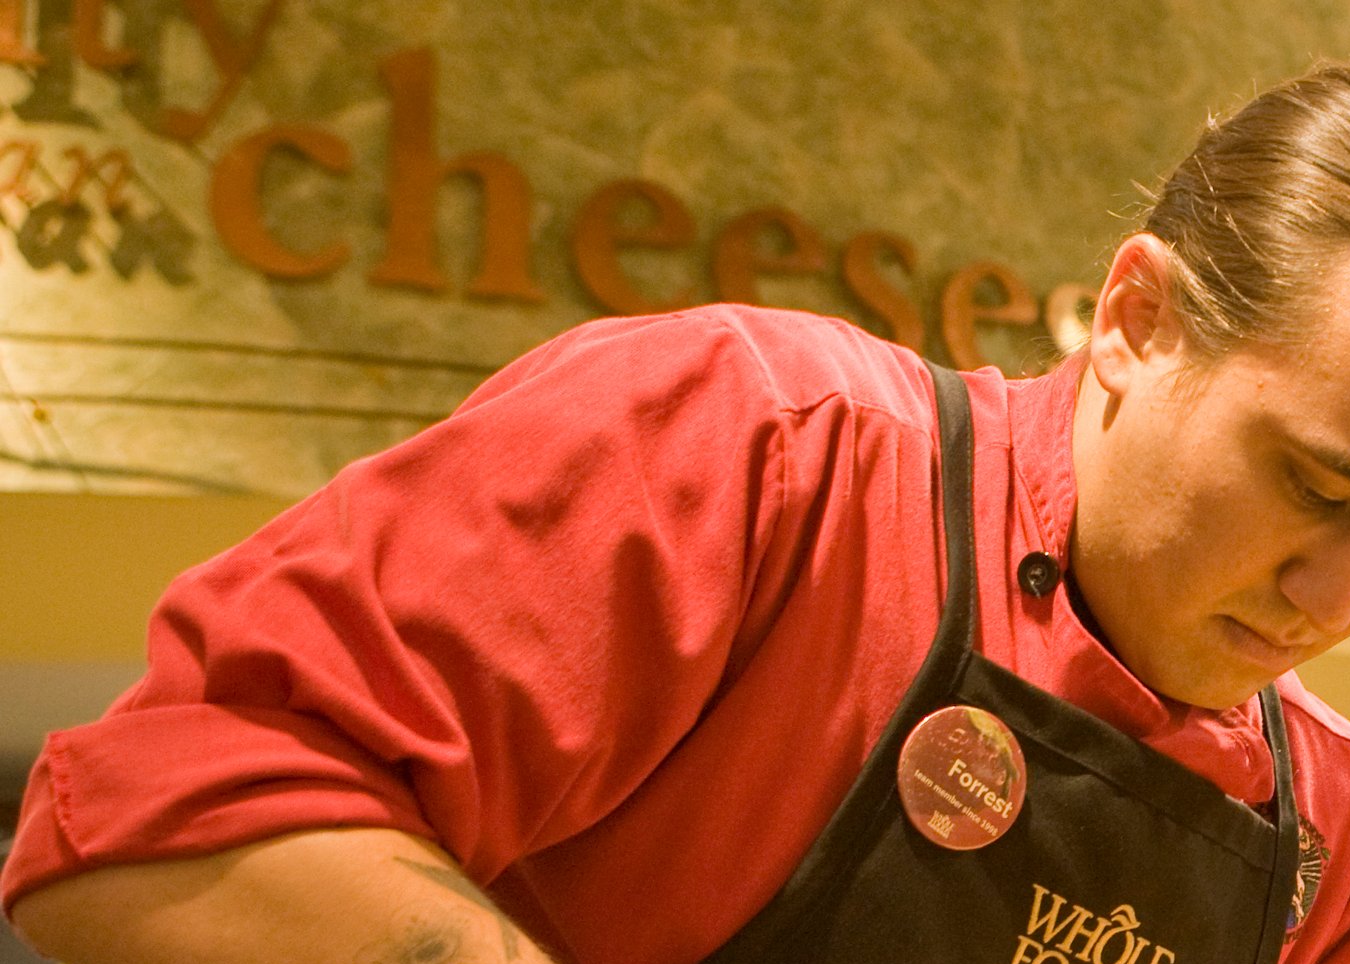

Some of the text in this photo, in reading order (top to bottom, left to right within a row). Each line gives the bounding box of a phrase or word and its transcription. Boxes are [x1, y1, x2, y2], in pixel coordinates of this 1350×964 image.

[914, 769, 934, 789] team
[933, 783, 963, 809] member
[962, 805, 981, 824] since
[948, 759, 1013, 818] Forrest
